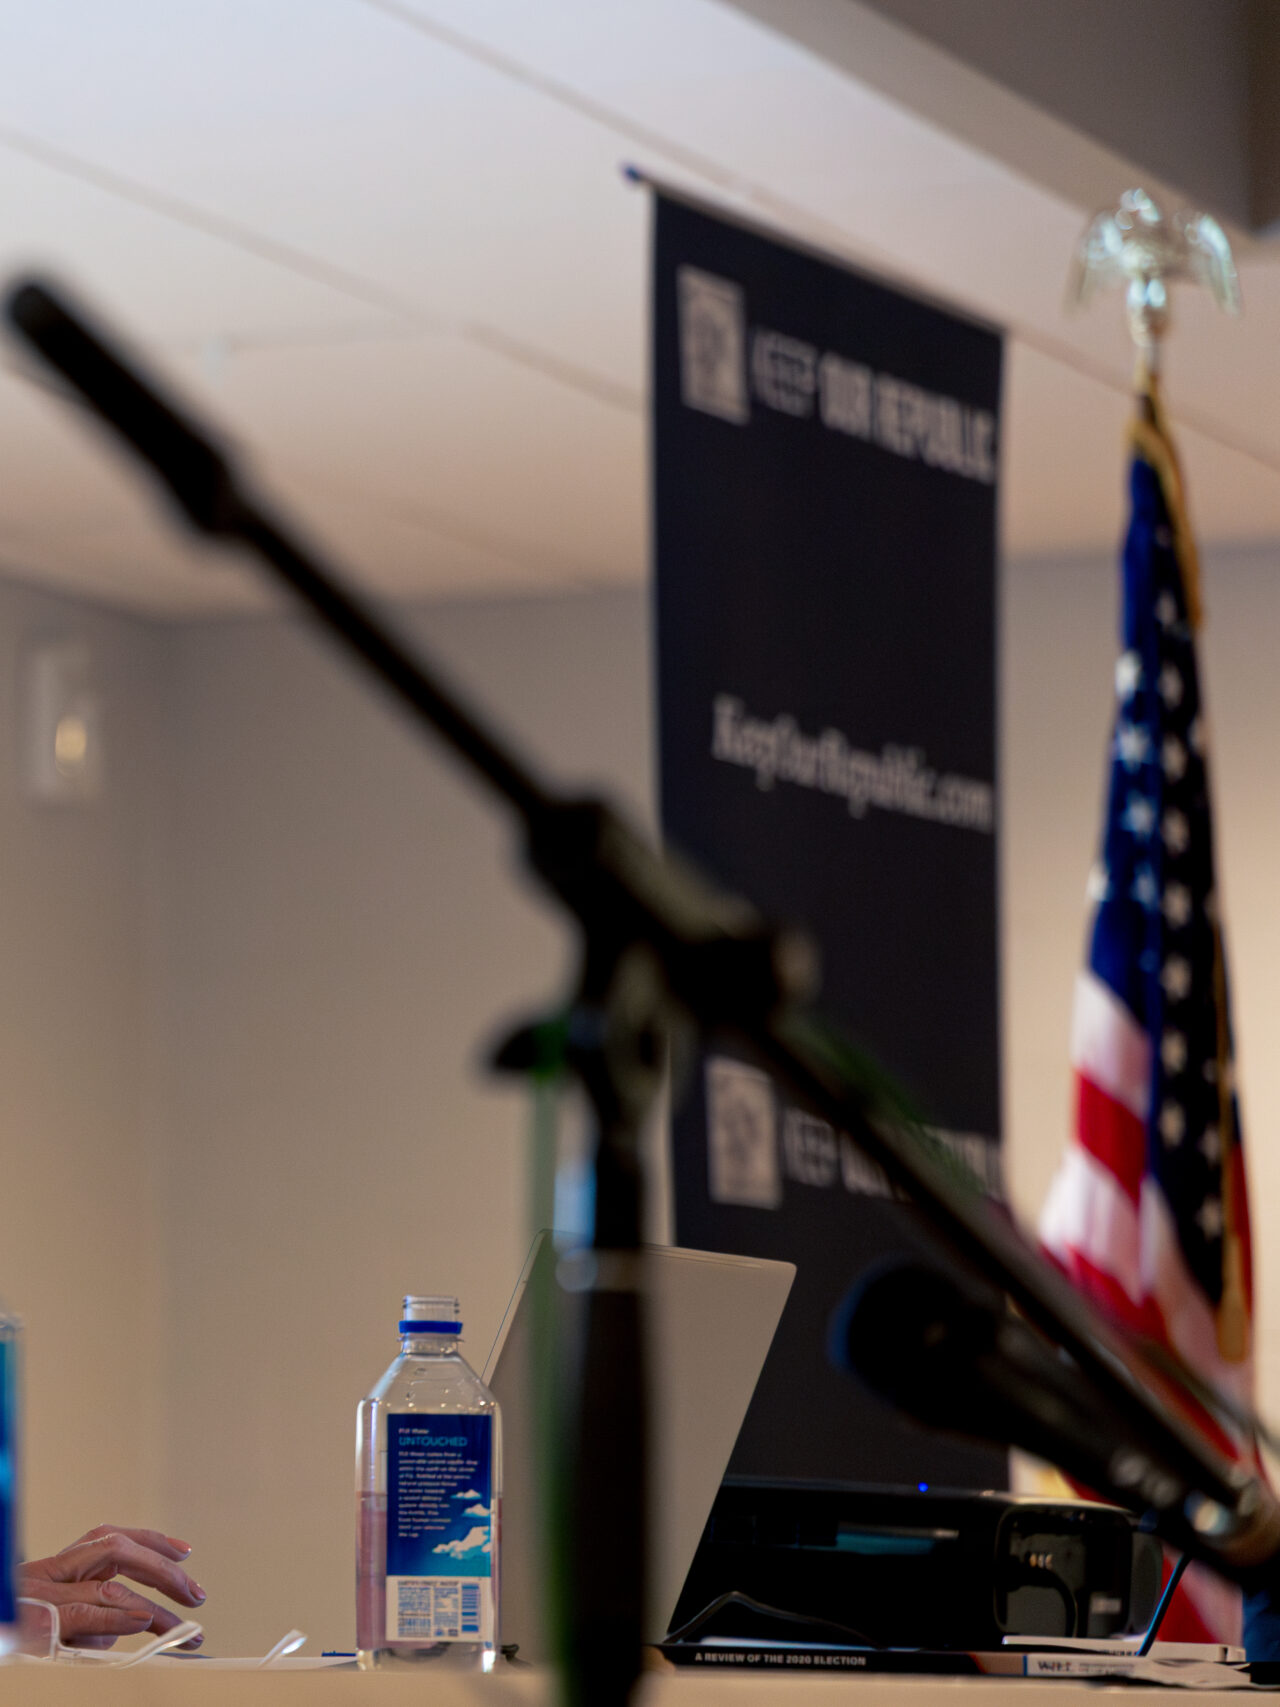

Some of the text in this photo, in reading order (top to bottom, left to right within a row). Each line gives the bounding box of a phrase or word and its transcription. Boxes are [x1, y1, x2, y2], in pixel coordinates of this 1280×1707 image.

[398, 1436, 468, 1447] UNTOUCHED
[695, 1652, 867, 1666] A REVIEW OF THE 2020 ELECTION
